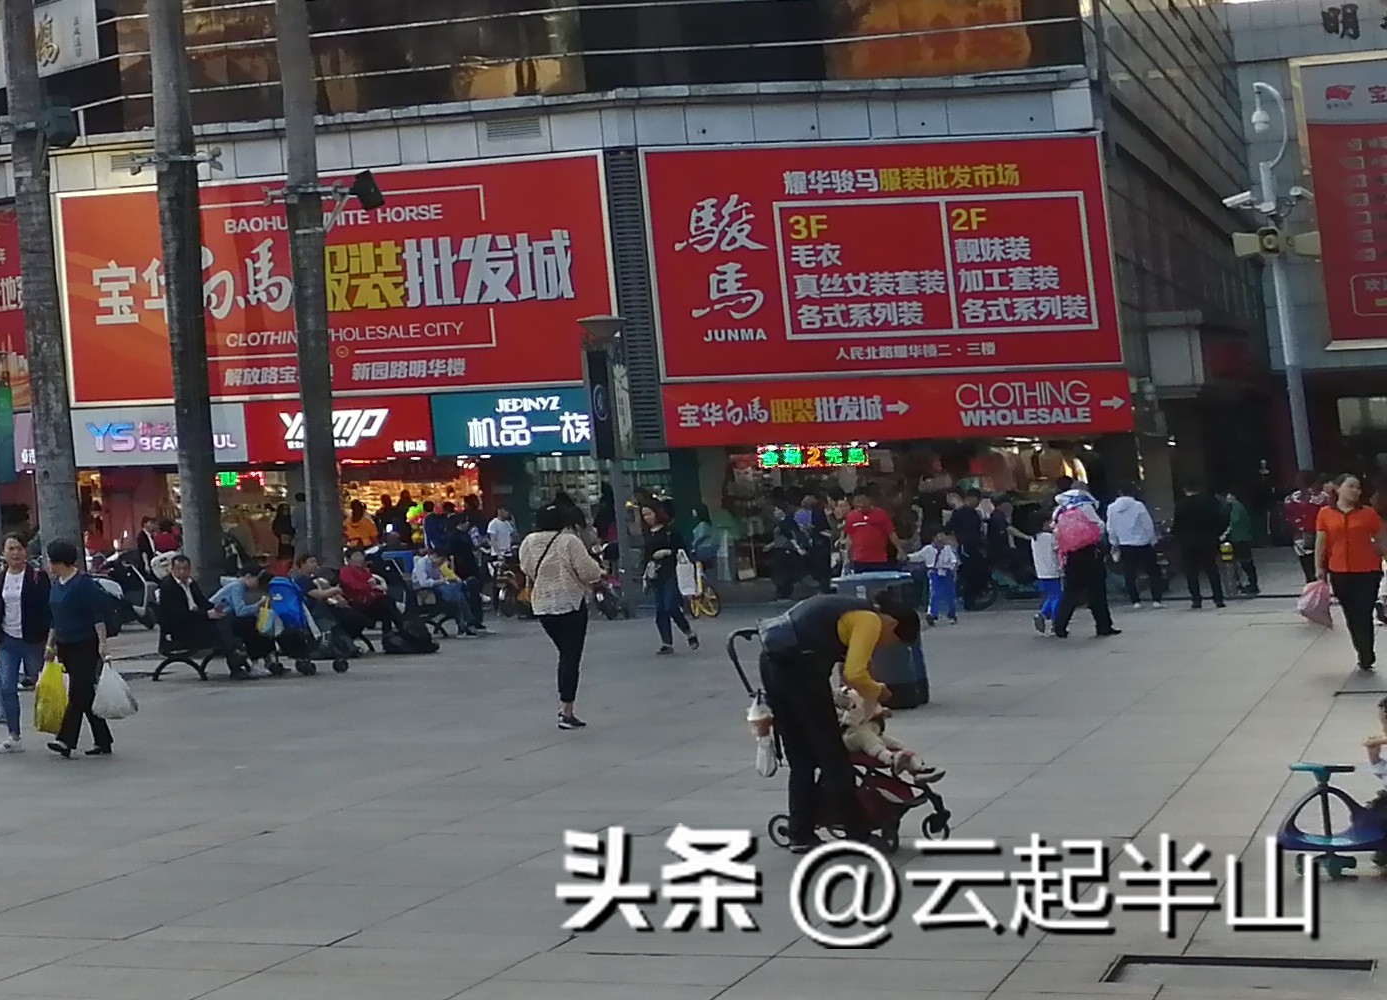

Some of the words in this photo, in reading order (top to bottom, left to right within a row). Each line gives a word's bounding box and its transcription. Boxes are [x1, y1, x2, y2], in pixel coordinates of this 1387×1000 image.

[783, 163, 1020, 195] 耀华骏马服装批发市场
[225, 216, 288, 235] BAOHU
[377, 204, 443, 223] HORSE
[789, 214, 827, 239] 3F
[951, 207, 987, 232] 2F
[791, 243, 842, 268] 毛衣
[954, 236, 1031, 264] 靓妹装
[794, 270, 946, 299] 真丝女装套装
[959, 266, 1060, 293] 加工套装
[797, 301, 925, 329] 各式系列装
[963, 294, 1088, 324] 各式系列装
[226, 331, 298, 348] CLOTHIN
[329, 325, 421, 343] HOLESALE
[424, 321, 464, 337] CITY
[703, 328, 767, 343] JUNMA
[352, 358, 466, 381] 新园路明华楼
[495, 397, 560, 412] JEPINYZ
[955, 380, 1091, 409] CLOTHING
[467, 412, 591, 448] 机品一族
[960, 407, 1092, 427] WHOLESALE
[86, 422, 134, 452] YS
